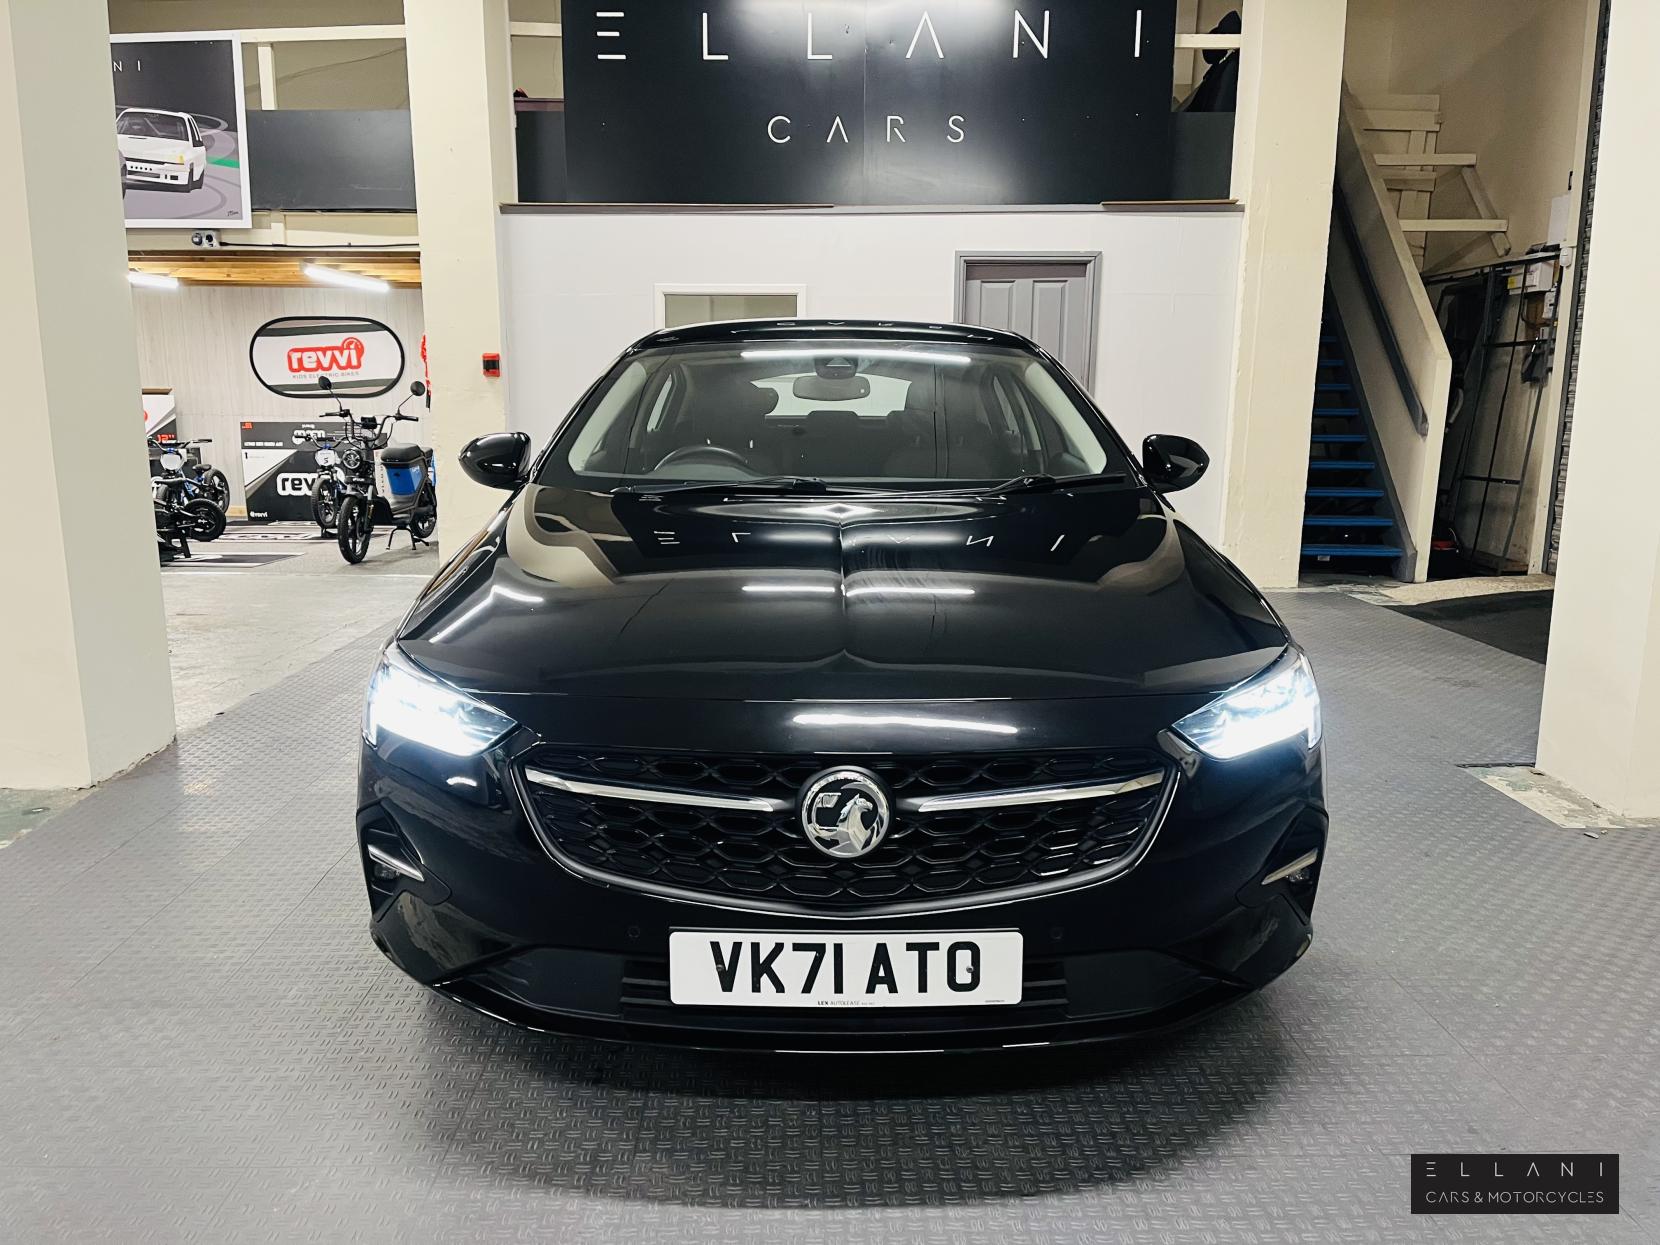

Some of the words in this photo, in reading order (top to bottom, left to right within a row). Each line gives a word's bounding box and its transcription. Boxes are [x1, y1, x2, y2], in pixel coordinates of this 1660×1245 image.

[596, 10, 1142, 60] ELLANI
[767, 115, 965, 144] CARS
[289, 345, 361, 370] revvi
[709, 940, 844, 995] VK71
[865, 940, 981, 995] ATO
